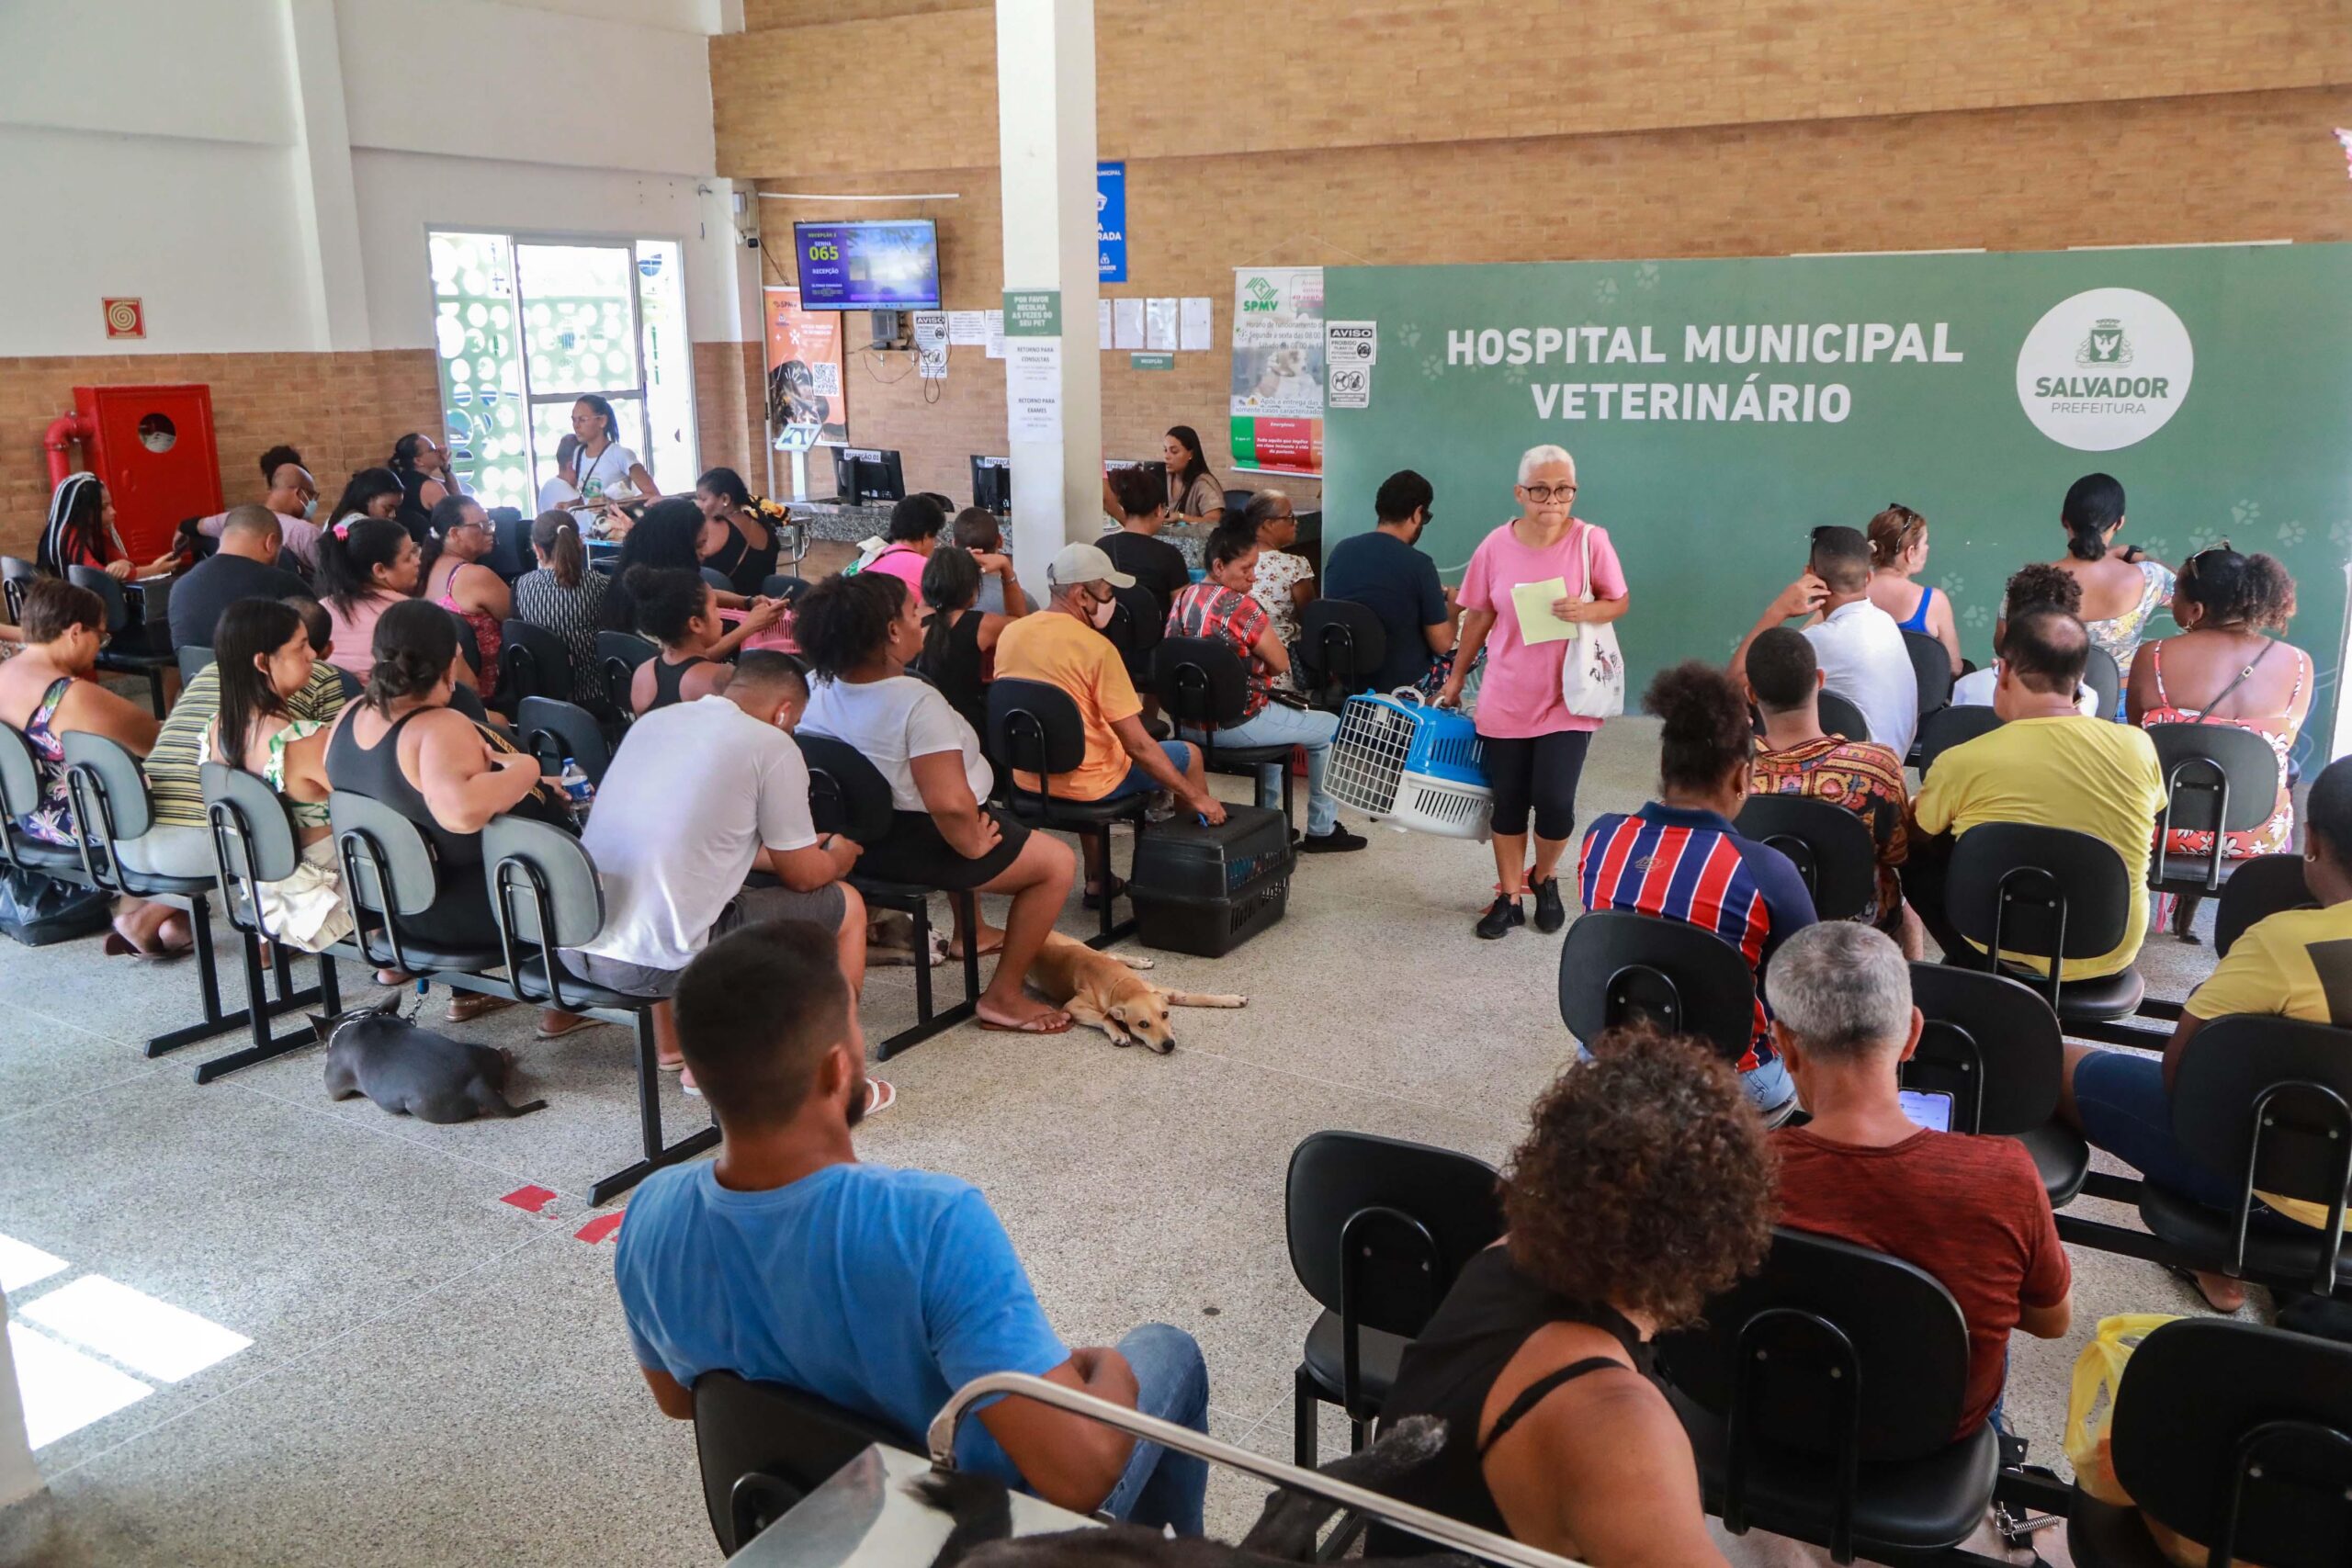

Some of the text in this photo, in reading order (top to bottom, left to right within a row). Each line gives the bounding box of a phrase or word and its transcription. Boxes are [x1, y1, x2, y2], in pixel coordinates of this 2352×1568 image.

[809, 246, 840, 261] 065
[1243, 300, 1279, 311] SPMV
[1250, 332, 1272, 340] Segunda
[1332, 329, 1372, 338] AVISO
[1448, 322, 1964, 365] HOSPITAL MUNICIPAL
[2034, 377, 2169, 399] SALVADOR
[1531, 372, 1851, 423] VETERINÁRIO
[2051, 402, 2146, 413] PREFEITURA
